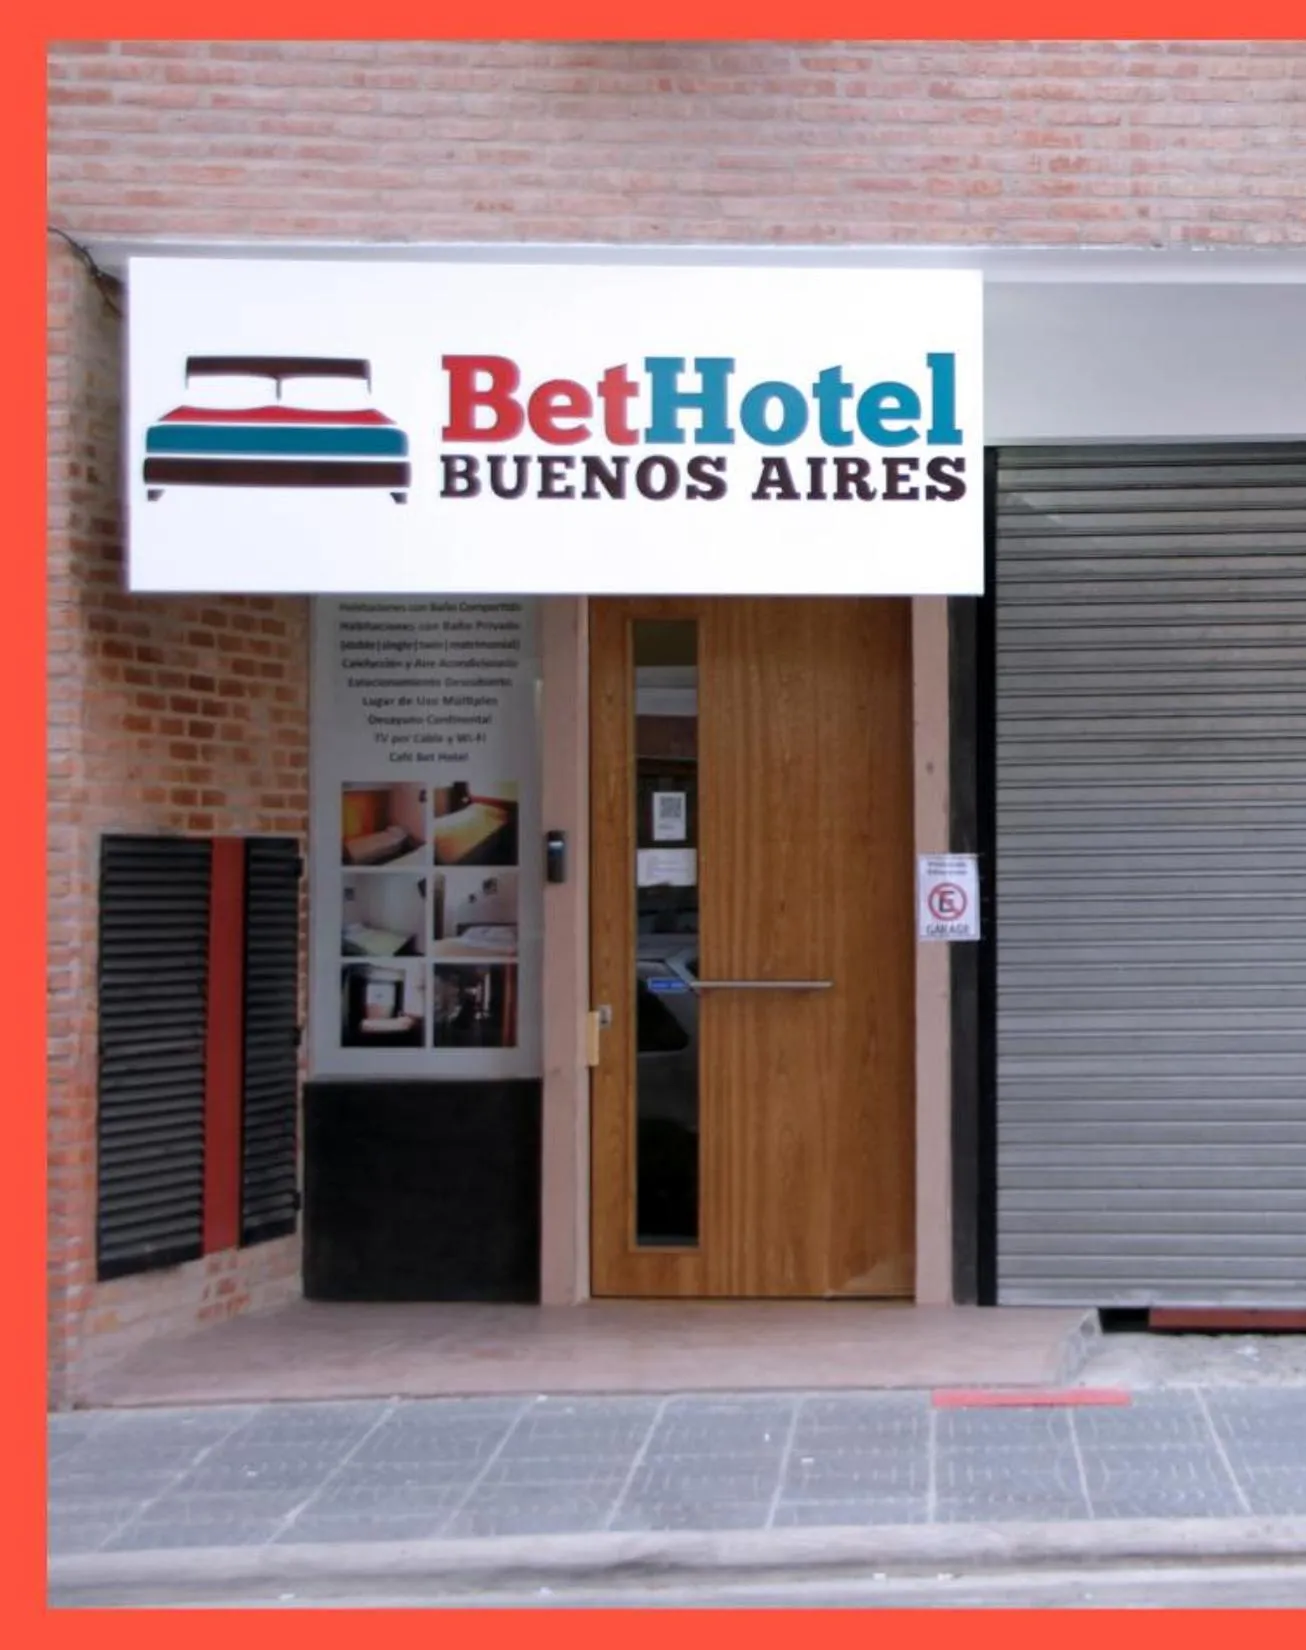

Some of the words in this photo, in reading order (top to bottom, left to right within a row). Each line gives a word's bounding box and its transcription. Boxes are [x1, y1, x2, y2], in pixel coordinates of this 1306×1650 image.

[441, 353, 963, 447] BetHotel
[440, 454, 728, 501] BUENOS
[752, 456, 967, 502] AIRES
